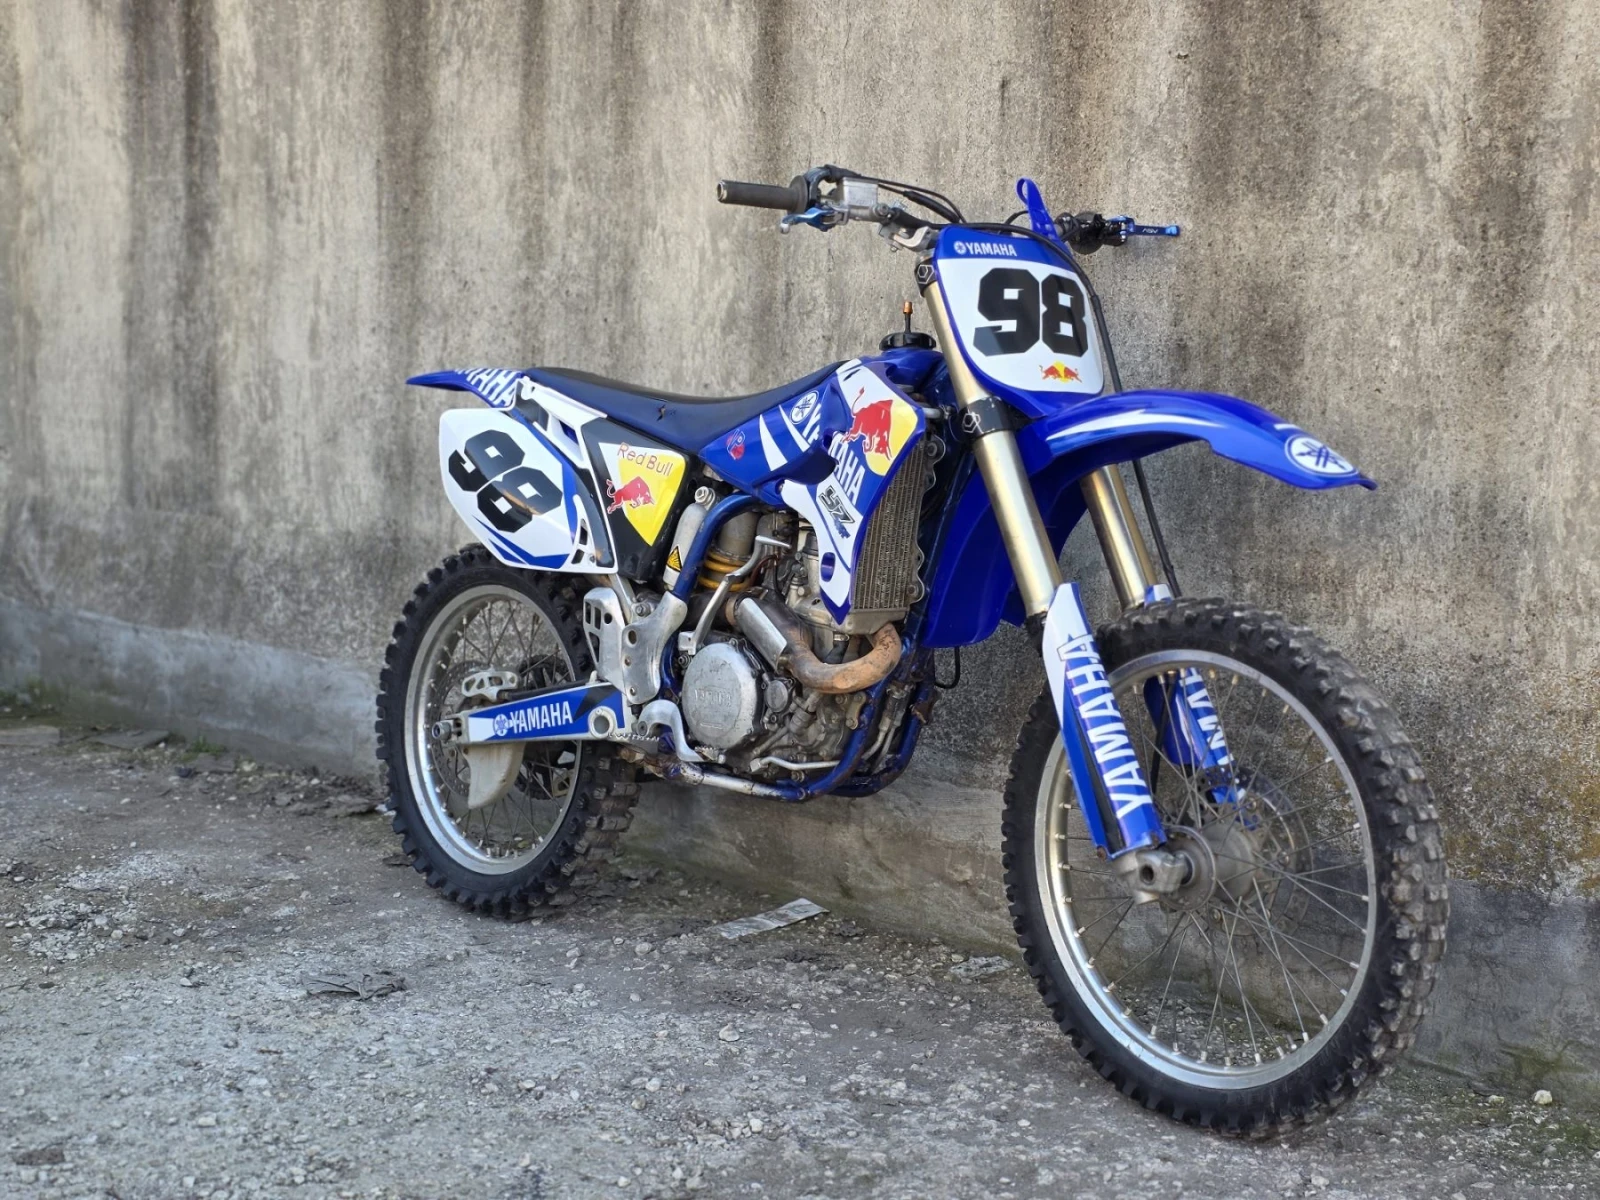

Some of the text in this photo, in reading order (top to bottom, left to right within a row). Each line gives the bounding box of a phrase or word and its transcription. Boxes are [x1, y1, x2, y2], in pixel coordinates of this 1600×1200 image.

[966, 243, 1017, 257] YAMAHA
[973, 267, 1089, 358] 98
[617, 442, 673, 476] Red Bull
[448, 429, 563, 533] 98
[818, 485, 855, 523] YZ
[509, 701, 573, 734] YAMAHA
[1056, 633, 1152, 820] YAMAHA
